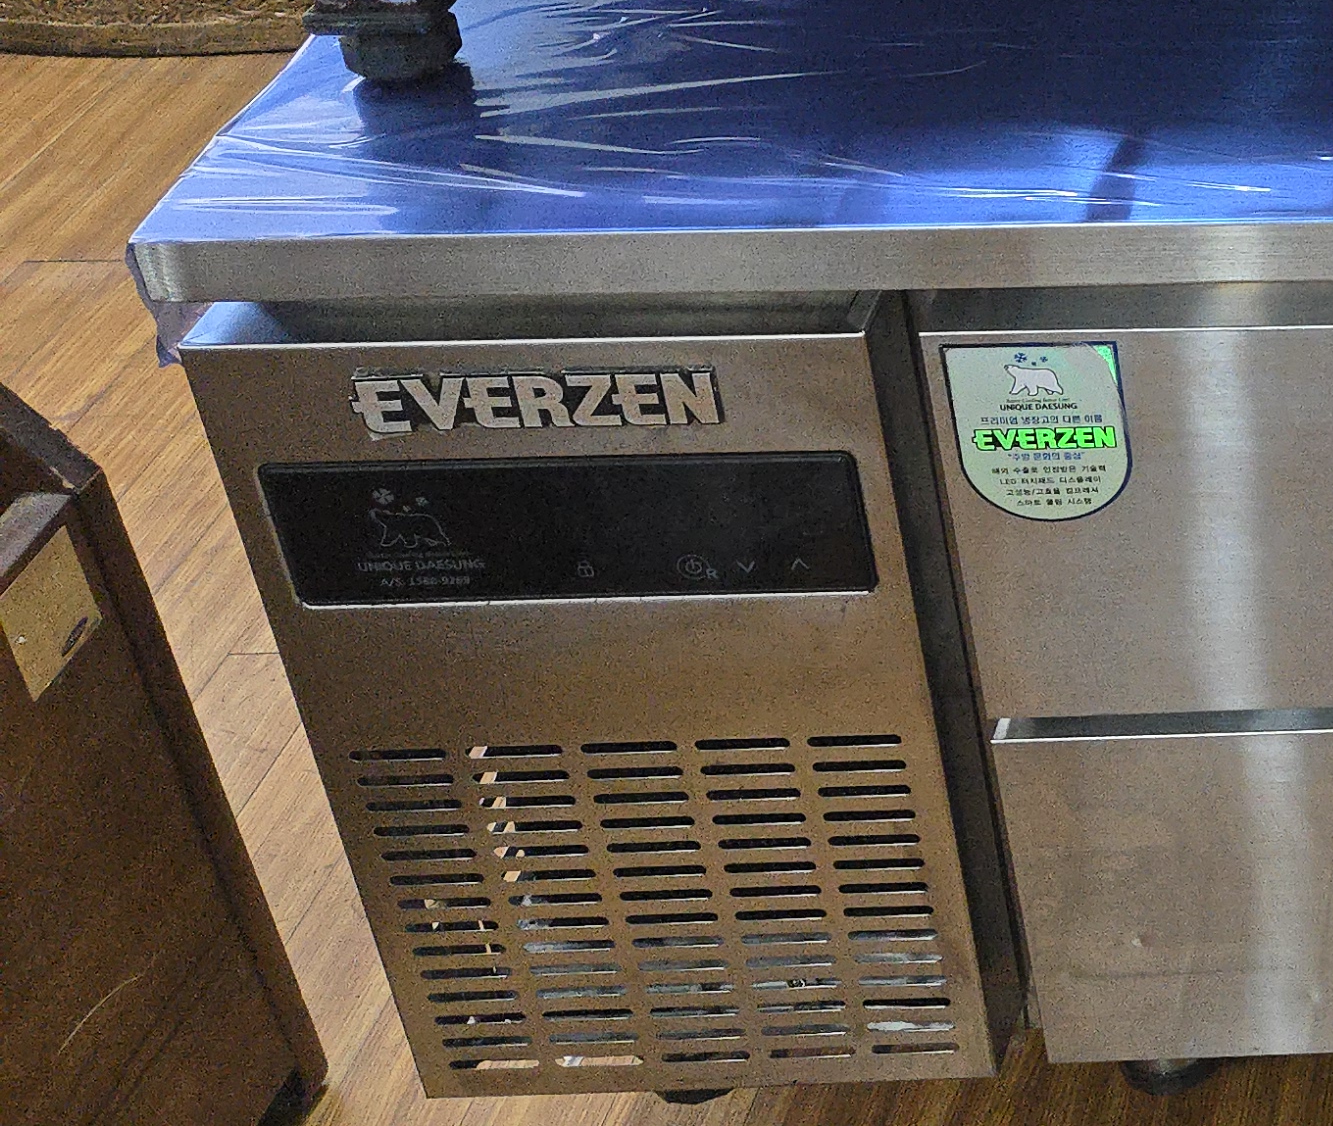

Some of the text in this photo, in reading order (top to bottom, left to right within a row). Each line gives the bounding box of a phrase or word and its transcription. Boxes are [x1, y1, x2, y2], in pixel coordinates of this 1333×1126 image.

[350, 371, 723, 434] EVERZEN
[1035, 402, 1078, 410] DAESUNG
[972, 426, 1118, 451] EVERZEN
[357, 560, 413, 572] UNIQUE
